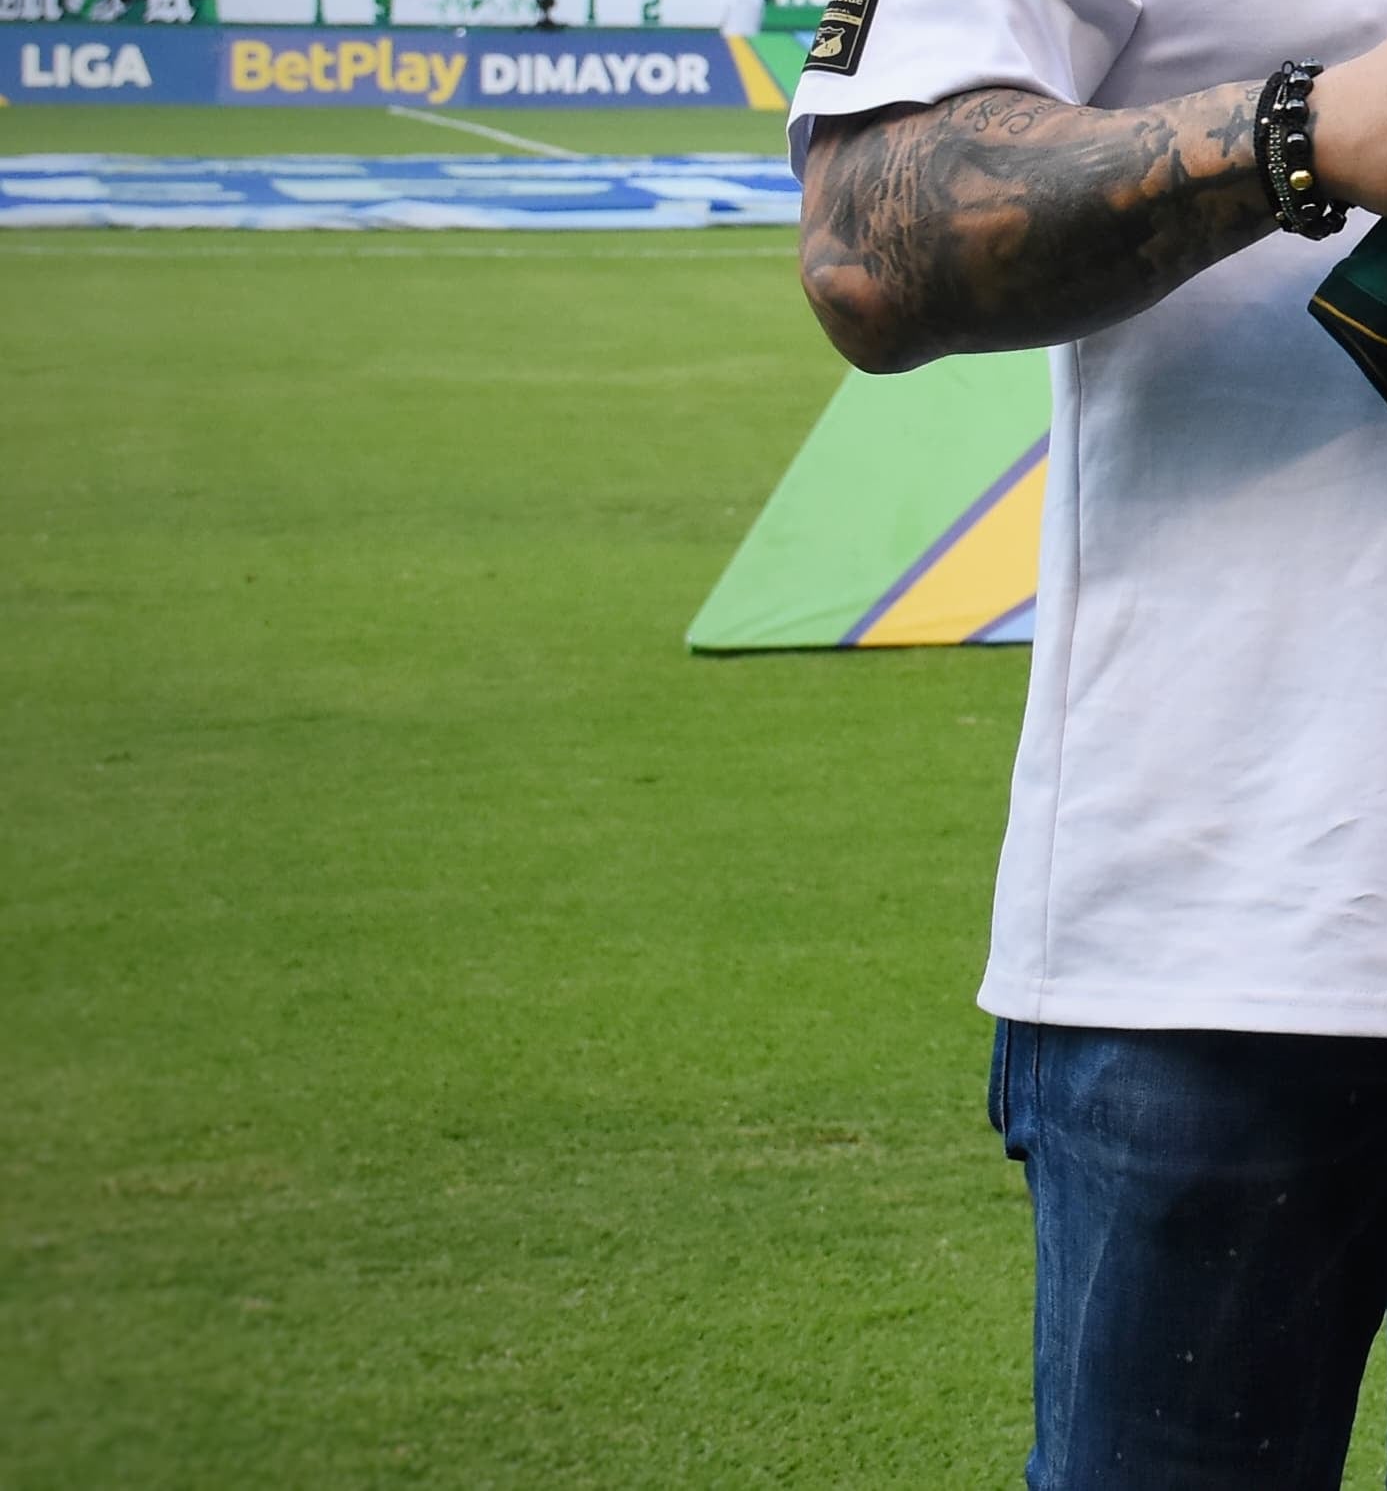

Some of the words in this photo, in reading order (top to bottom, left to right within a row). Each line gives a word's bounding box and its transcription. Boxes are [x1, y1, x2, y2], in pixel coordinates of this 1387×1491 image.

[21, 42, 153, 89] LIGA
[231, 40, 467, 102] BetPlay
[480, 53, 710, 96] DIMAYOR
